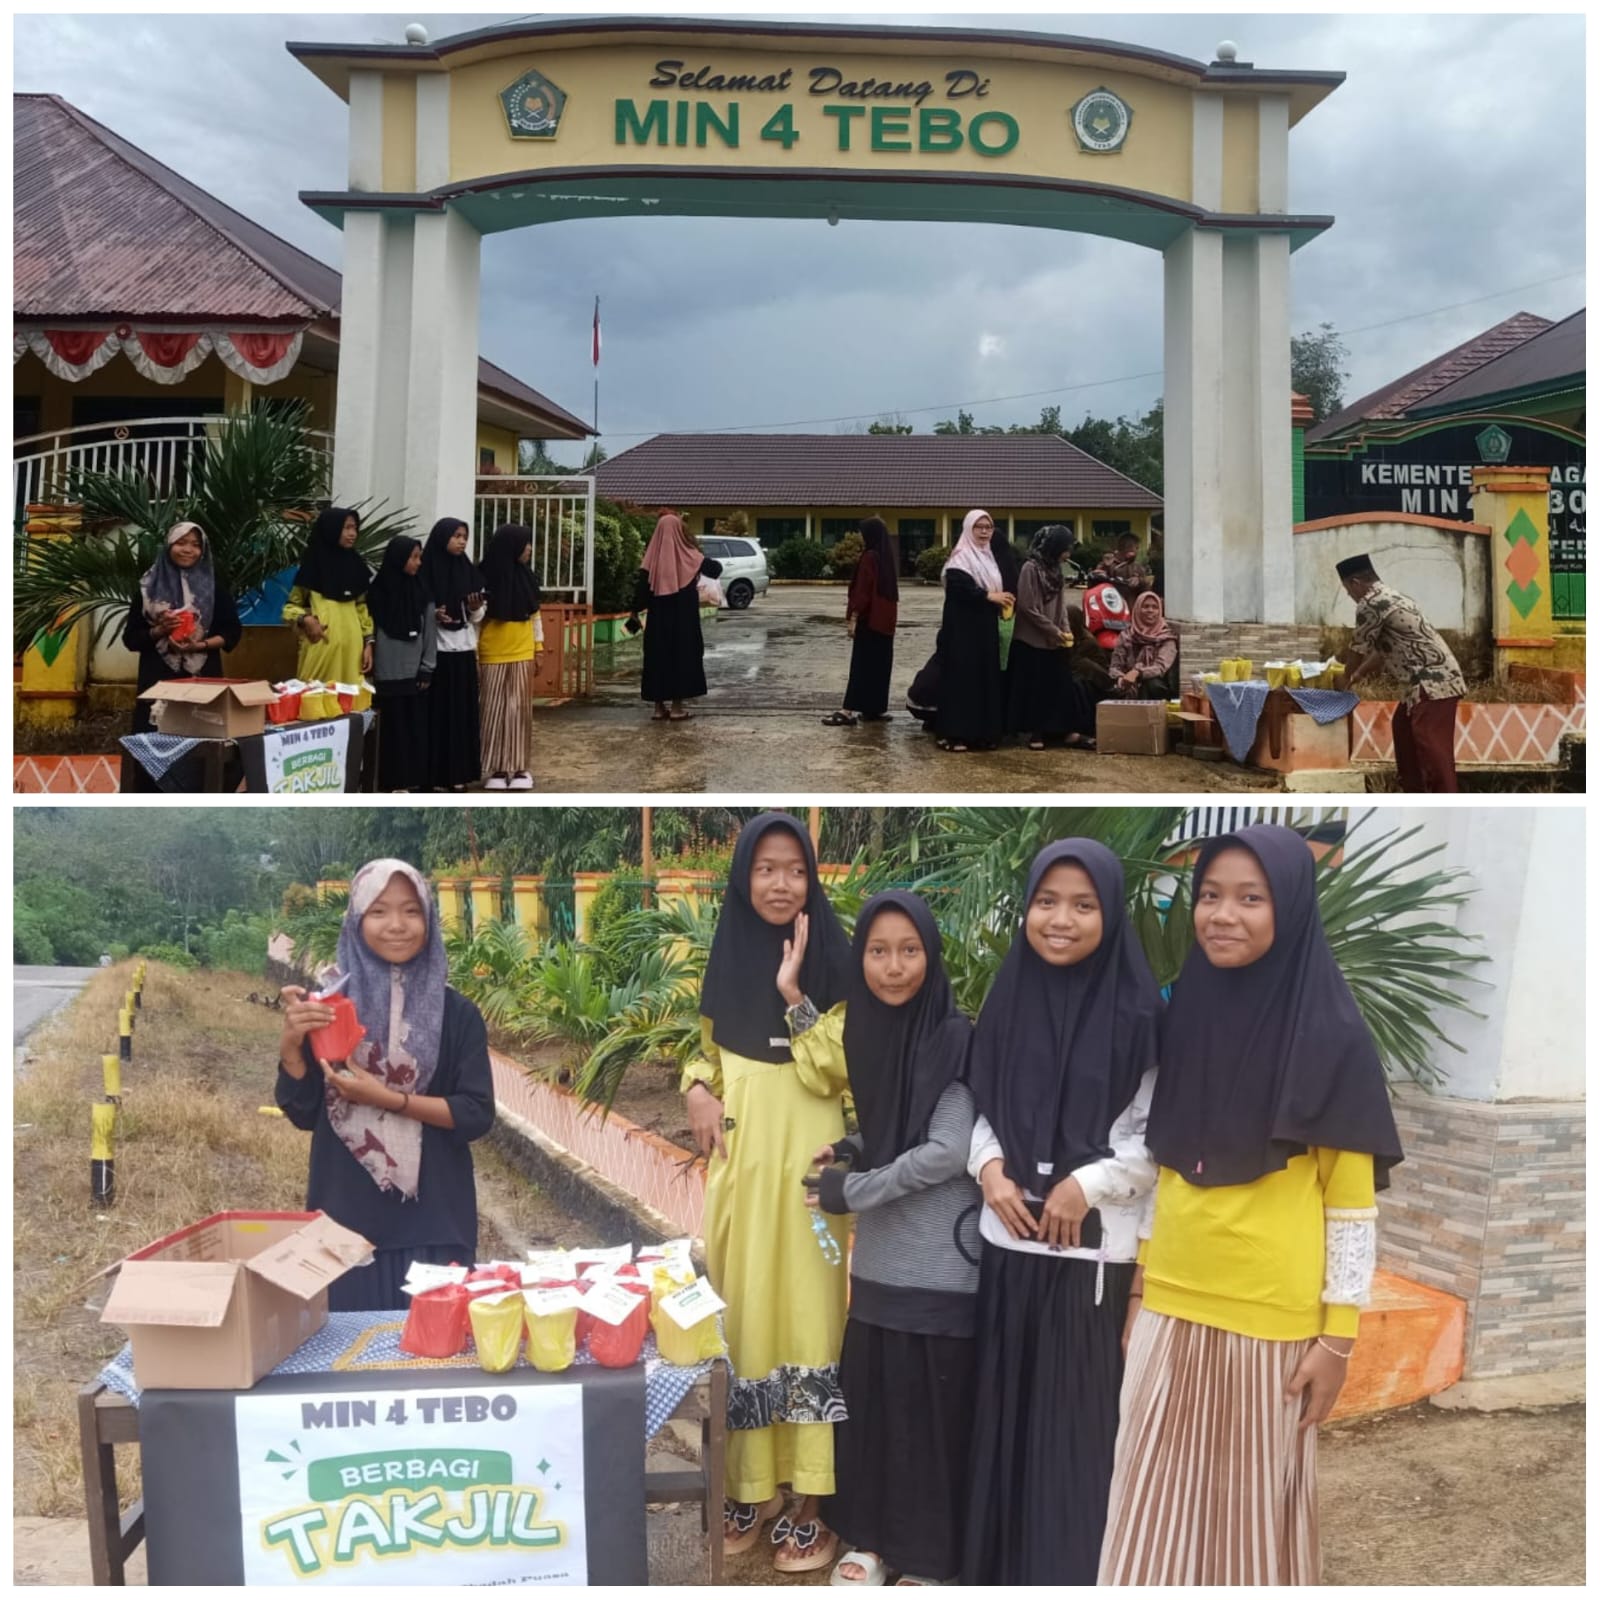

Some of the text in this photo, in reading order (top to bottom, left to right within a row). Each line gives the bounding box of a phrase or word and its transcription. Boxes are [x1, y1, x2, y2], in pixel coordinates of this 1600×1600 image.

[650, 60, 991, 107] Selamat Datang Di
[614, 99, 739, 148] MIN
[760, 104, 800, 150] 4
[823, 105, 1020, 157] TEBO
[1361, 464, 1480, 485] KEMENTE
[1401, 488, 1458, 514] MIN
[1550, 489, 1586, 514] BO
[291, 752, 326, 770] BERBAGI
[273, 766, 341, 793] TAKJIL
[302, 1394, 517, 1430] MIN 4 TEBO
[340, 1458, 480, 1488] BERBAGI
[264, 1490, 561, 1573] TAKJIL
